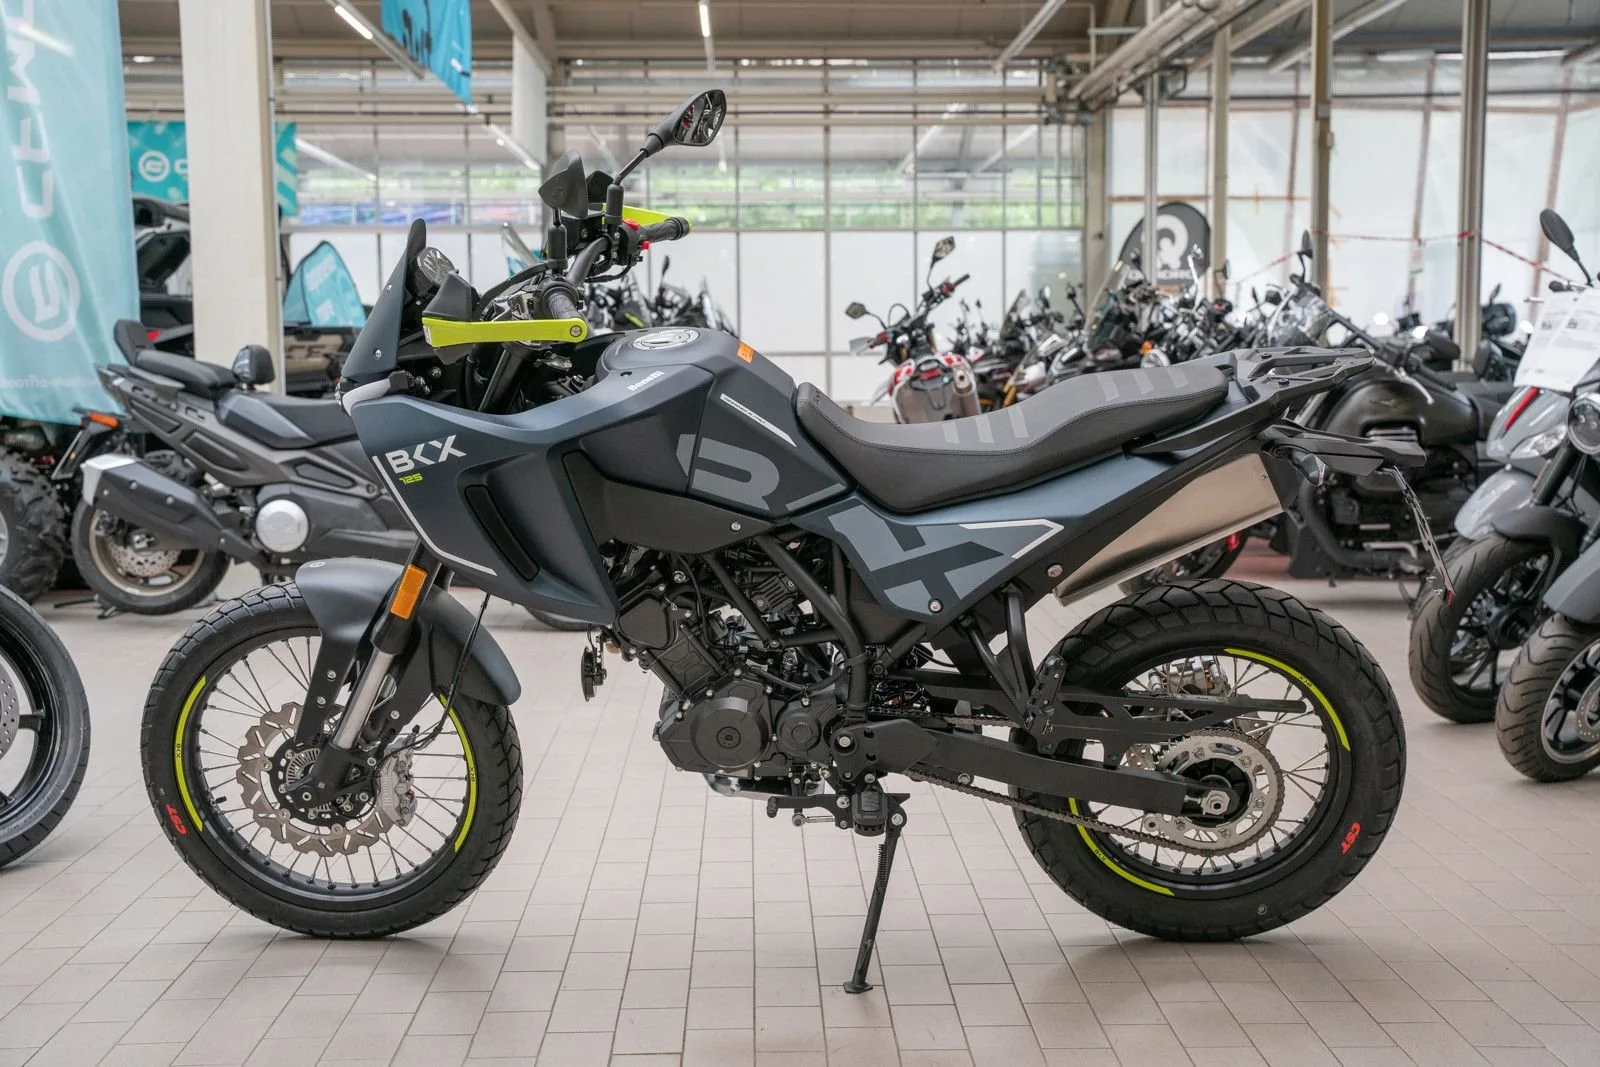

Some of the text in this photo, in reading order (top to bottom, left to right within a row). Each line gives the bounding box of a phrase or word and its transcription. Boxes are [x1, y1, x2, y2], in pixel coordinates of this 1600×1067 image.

[626, 370, 665, 392] Benelli
[385, 434, 467, 474] BKX
[399, 473, 424, 485] 125
[1341, 822, 1361, 855] CST
